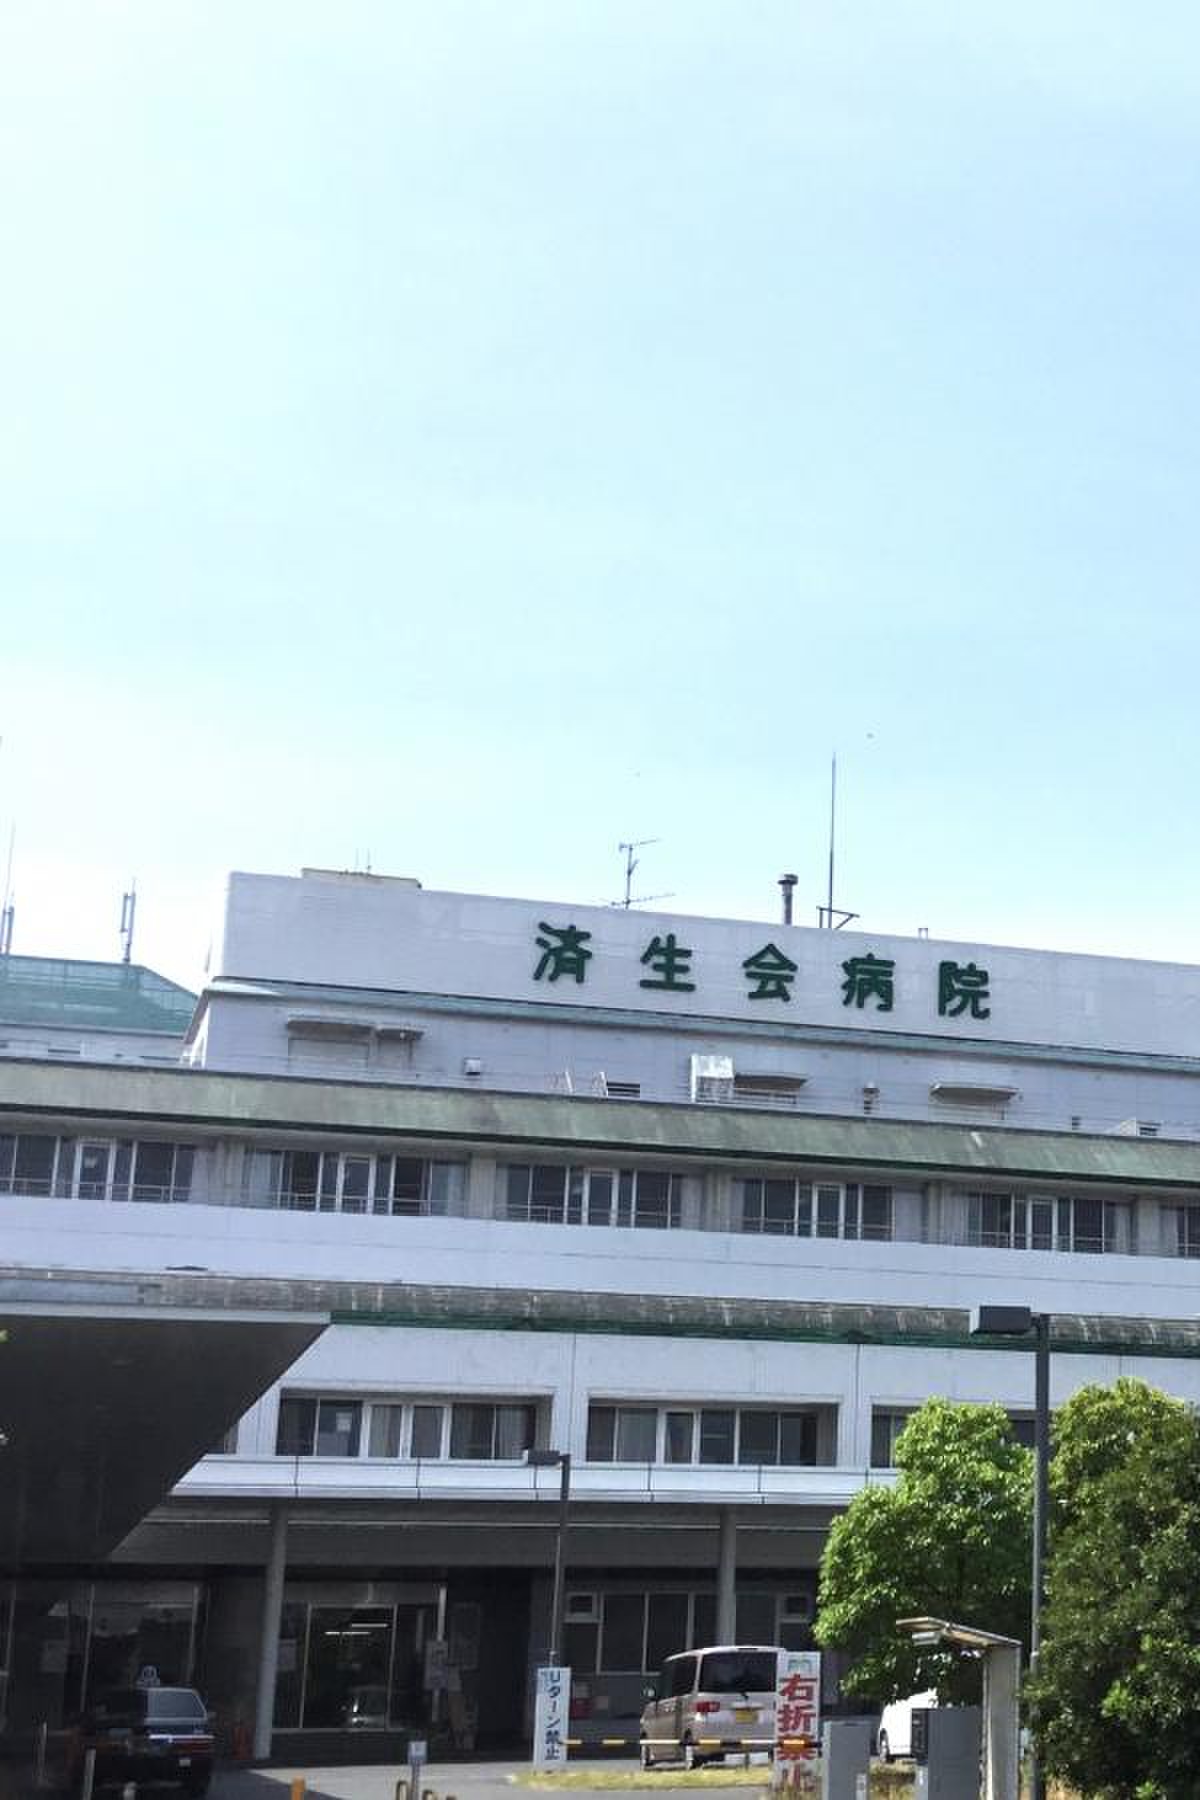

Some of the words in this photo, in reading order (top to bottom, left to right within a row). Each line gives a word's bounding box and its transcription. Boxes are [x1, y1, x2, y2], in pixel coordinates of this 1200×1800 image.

[533, 921, 990, 1020] 済生会病院
